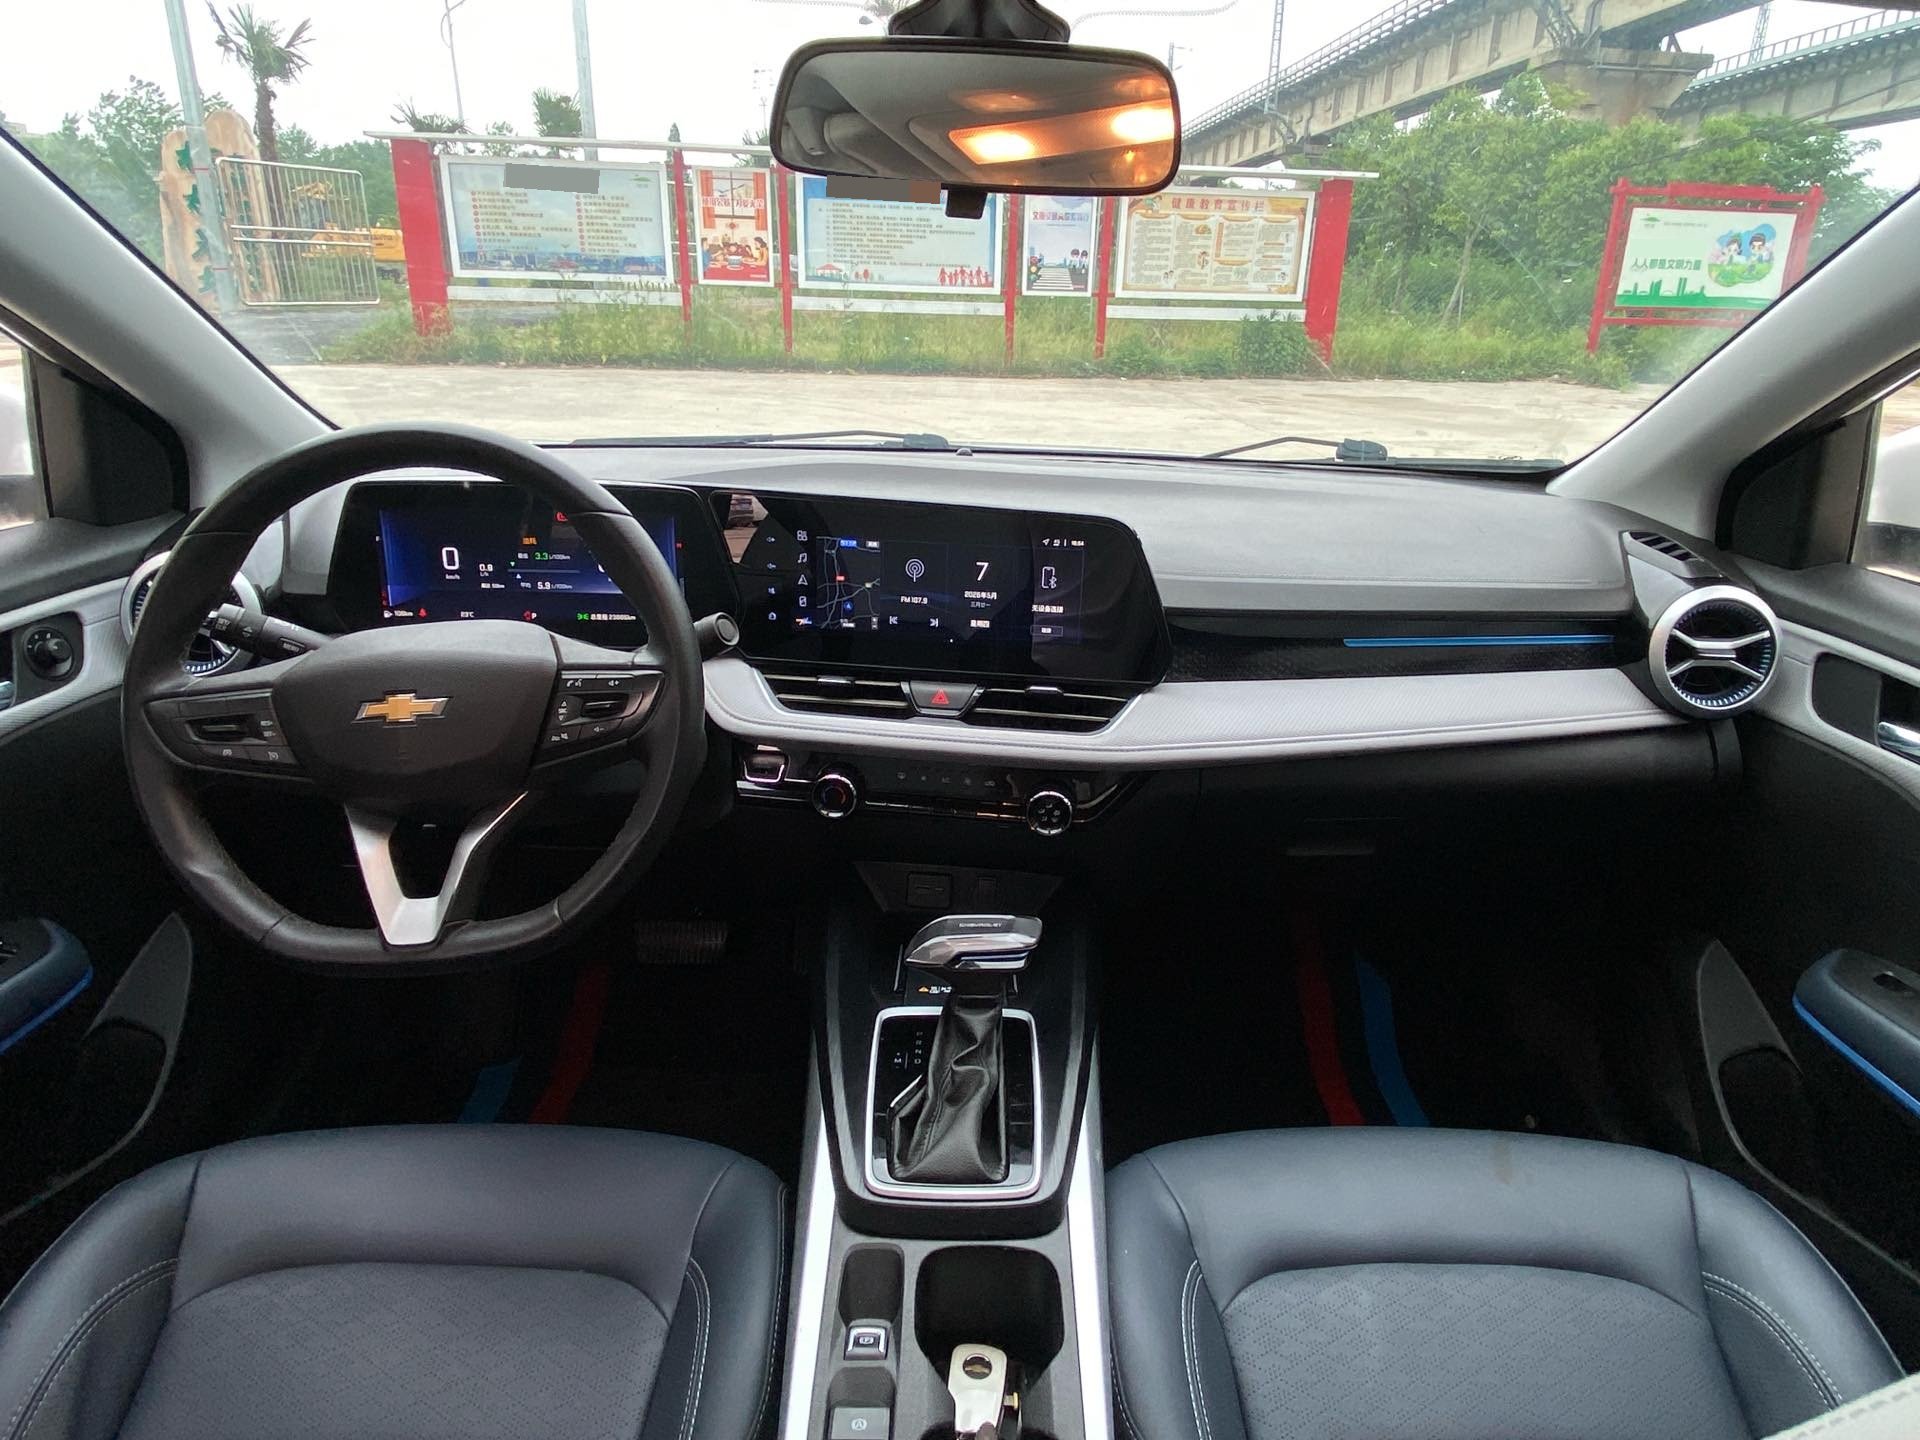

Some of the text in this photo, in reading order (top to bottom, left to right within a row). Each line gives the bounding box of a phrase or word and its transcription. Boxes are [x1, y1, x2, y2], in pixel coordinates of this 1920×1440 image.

[1172, 197, 1265, 213] 健康教育宣传栏
[441, 546, 460, 571] 0
[534, 551, 549, 560] 3.3
[975, 561, 990, 581] 7
[900, 595, 911, 603] FM
